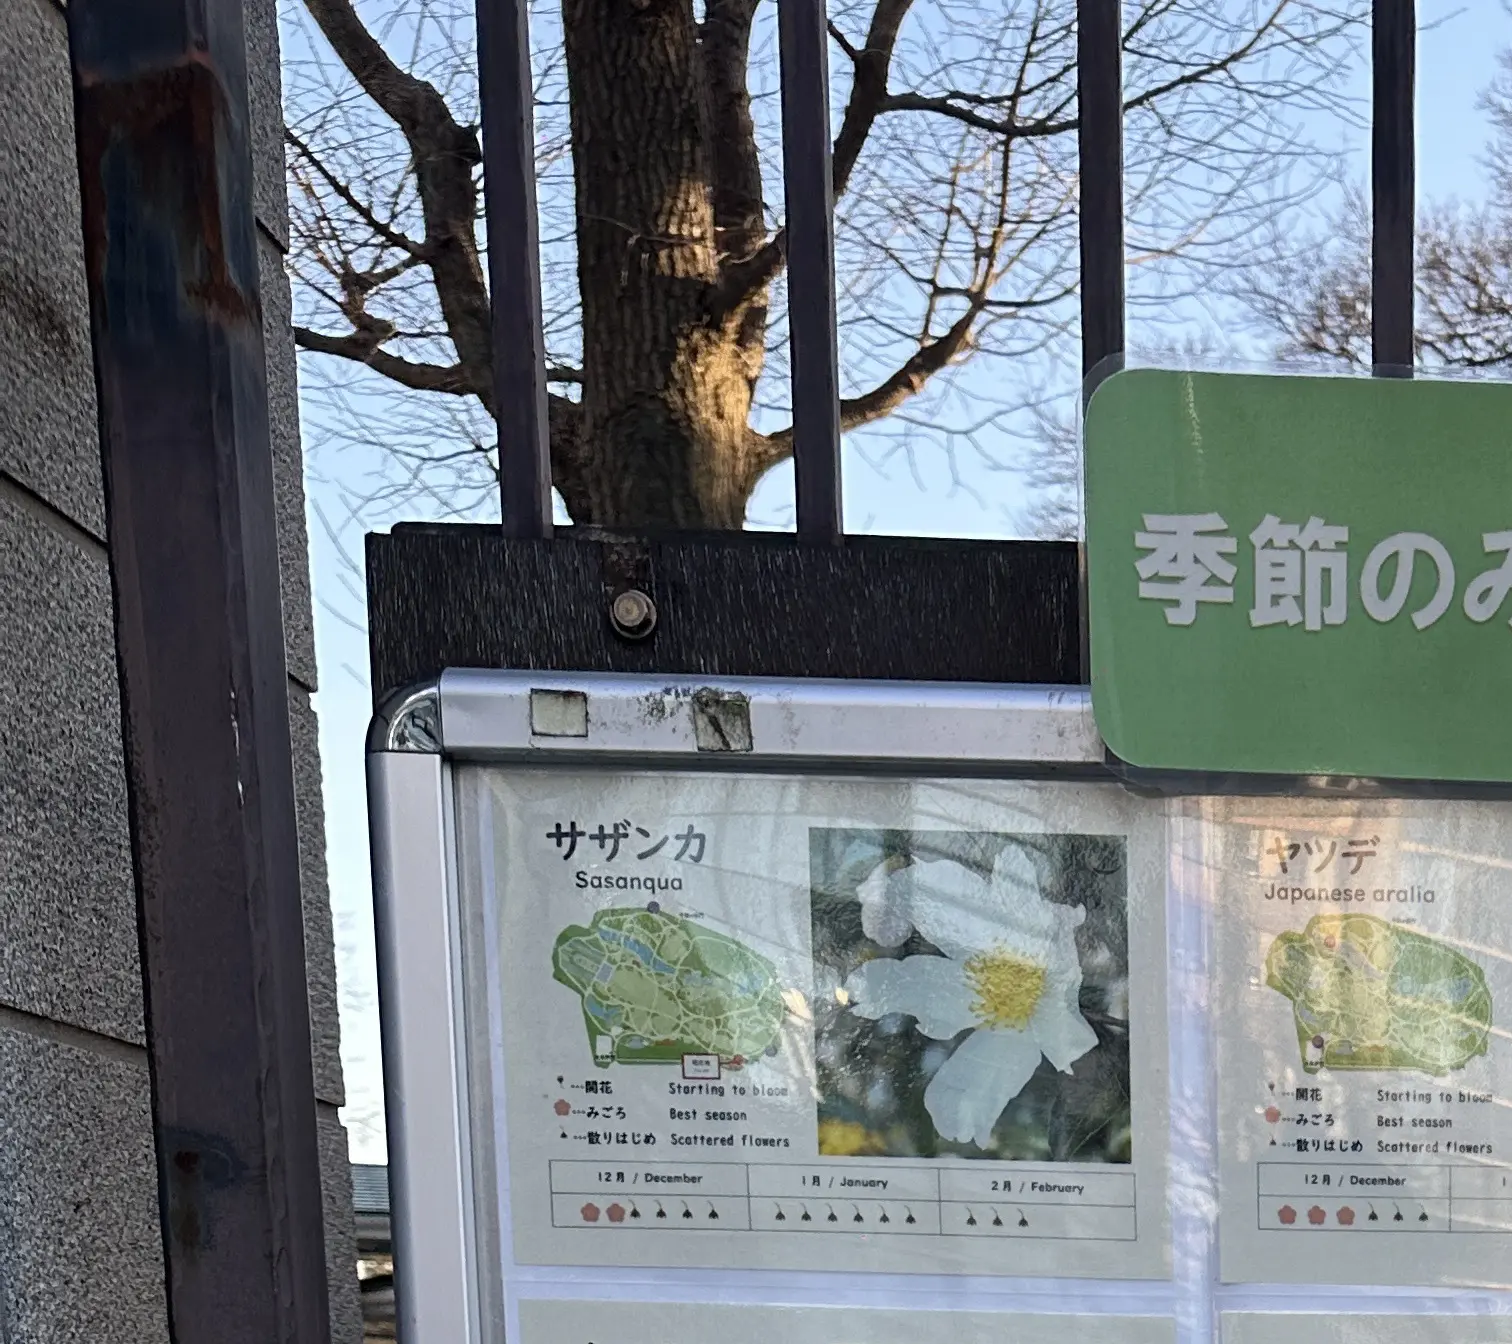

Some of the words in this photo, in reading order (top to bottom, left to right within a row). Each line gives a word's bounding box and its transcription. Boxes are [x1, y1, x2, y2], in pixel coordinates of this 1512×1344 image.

[545, 818, 706, 864] サザンカ
[1265, 833, 1381, 876] ヤツデ
[575, 870, 683, 895] Sasanqua
[1264, 882, 1366, 906] Japanese
[1372, 884, 1436, 904] aralia
